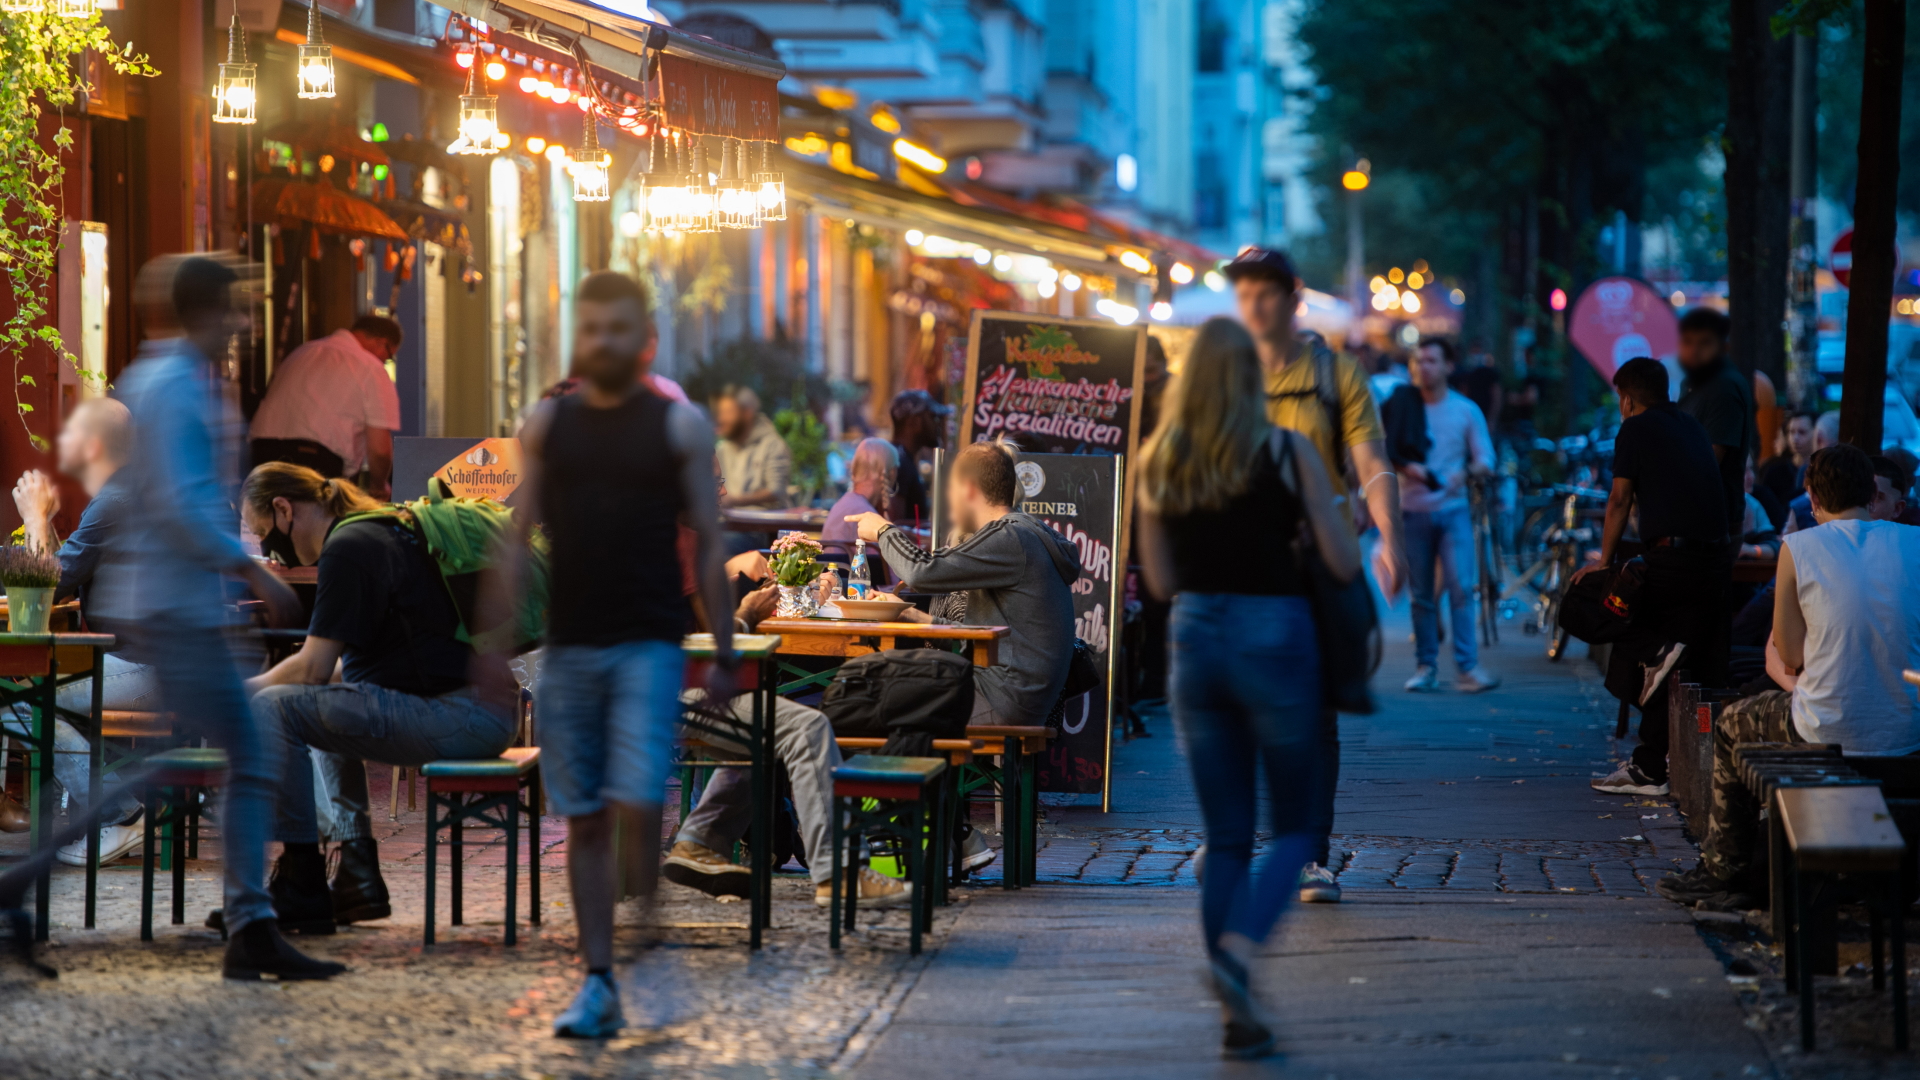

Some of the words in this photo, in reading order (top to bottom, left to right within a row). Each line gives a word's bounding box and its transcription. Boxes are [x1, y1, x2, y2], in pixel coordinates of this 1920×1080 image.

[982, 364, 1133, 403] Mexikanische
[995, 390, 1118, 420] Italienische
[974, 402, 1122, 445] Spezialitäten
[446, 466, 517, 486] Schöfferhofer
[465, 487, 497, 495] WEIZEN
[1022, 501, 1079, 516] TEINER
[1071, 577, 1093, 595] ND
